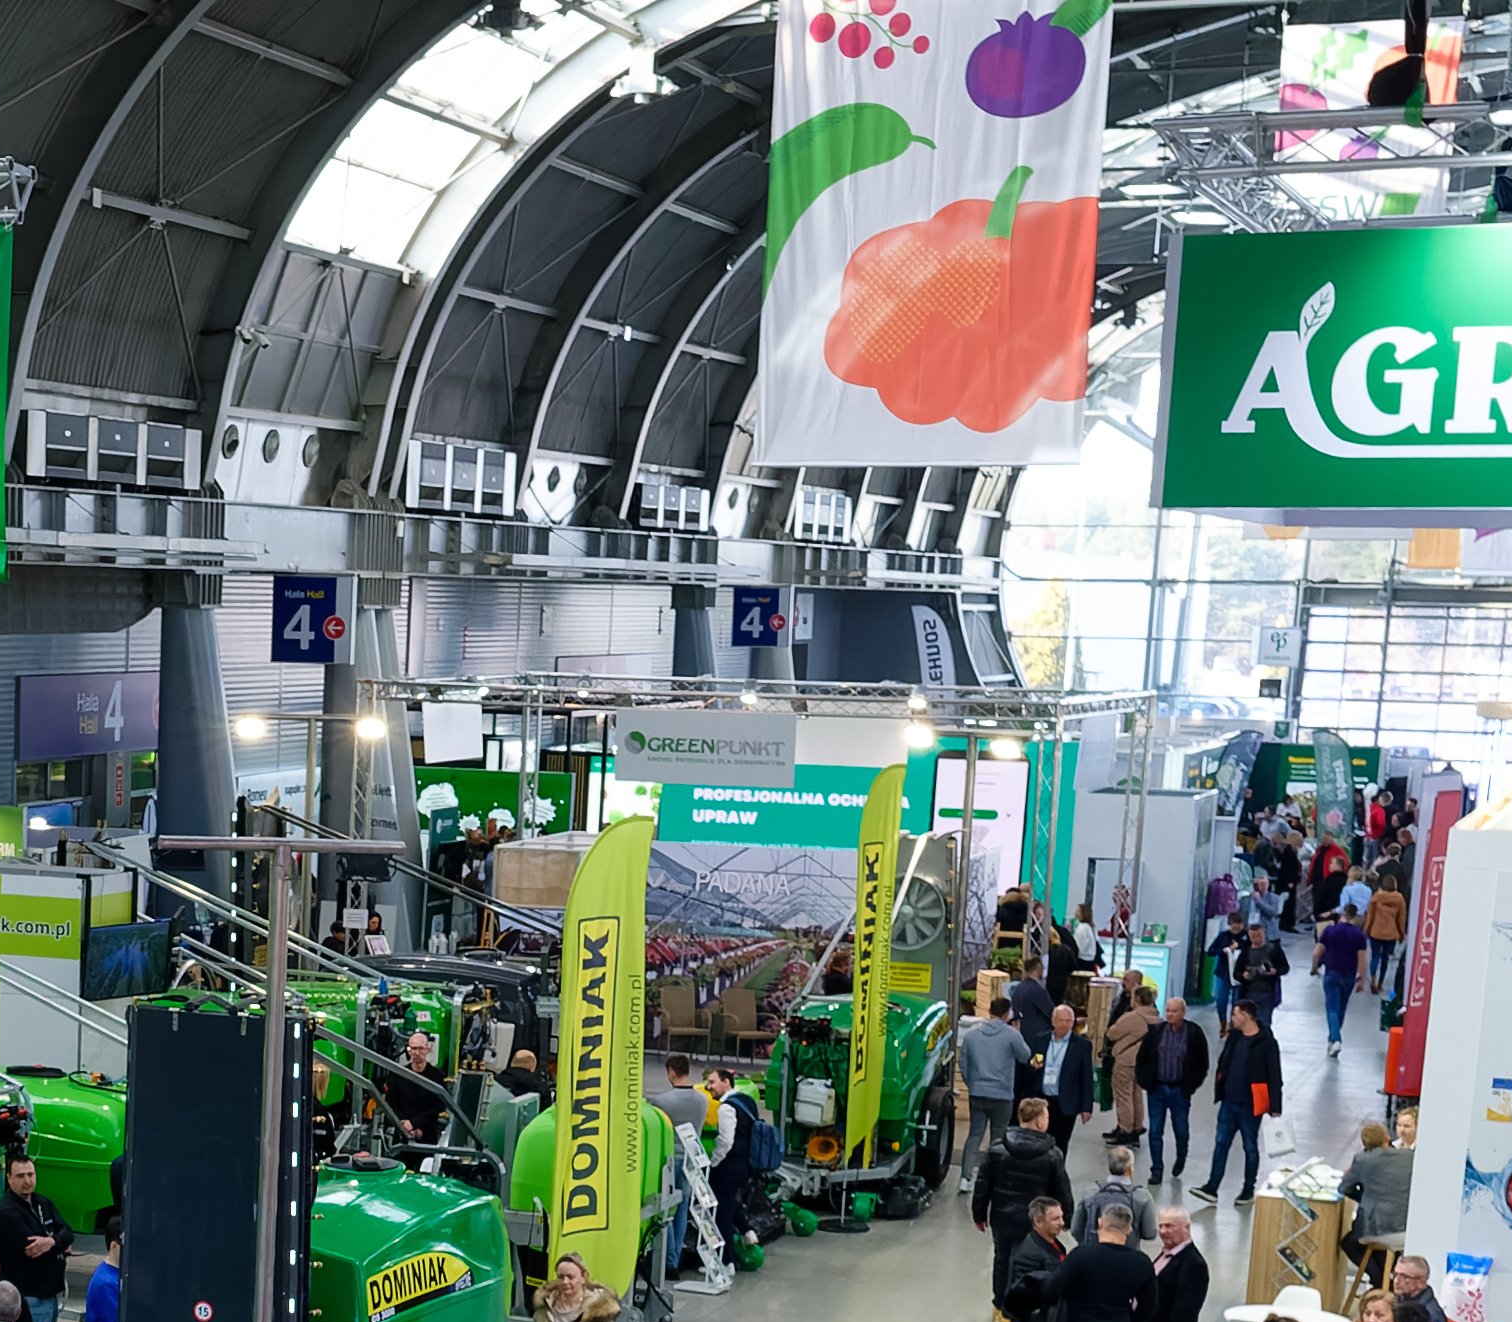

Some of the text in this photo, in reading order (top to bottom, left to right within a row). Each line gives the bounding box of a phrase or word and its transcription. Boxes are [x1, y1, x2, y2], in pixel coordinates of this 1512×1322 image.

[283, 604, 316, 651] 4
[739, 606, 764, 639] 4
[103, 681, 126, 742] 4
[647, 735, 787, 760] GREENPUNKT
[693, 809, 757, 825] UPRAW
[694, 787, 910, 811] PROFESJONALNA OCHA
[695, 870, 791, 899] PADANA
[856, 851, 880, 1075] DOMINIAK
[566, 930, 611, 1223] DOMINIAK
[626, 973, 644, 1175] www.dominiak.com.pl
[369, 1256, 449, 1311] DOMINIAK
[197, 1306, 210, 1318] 15
